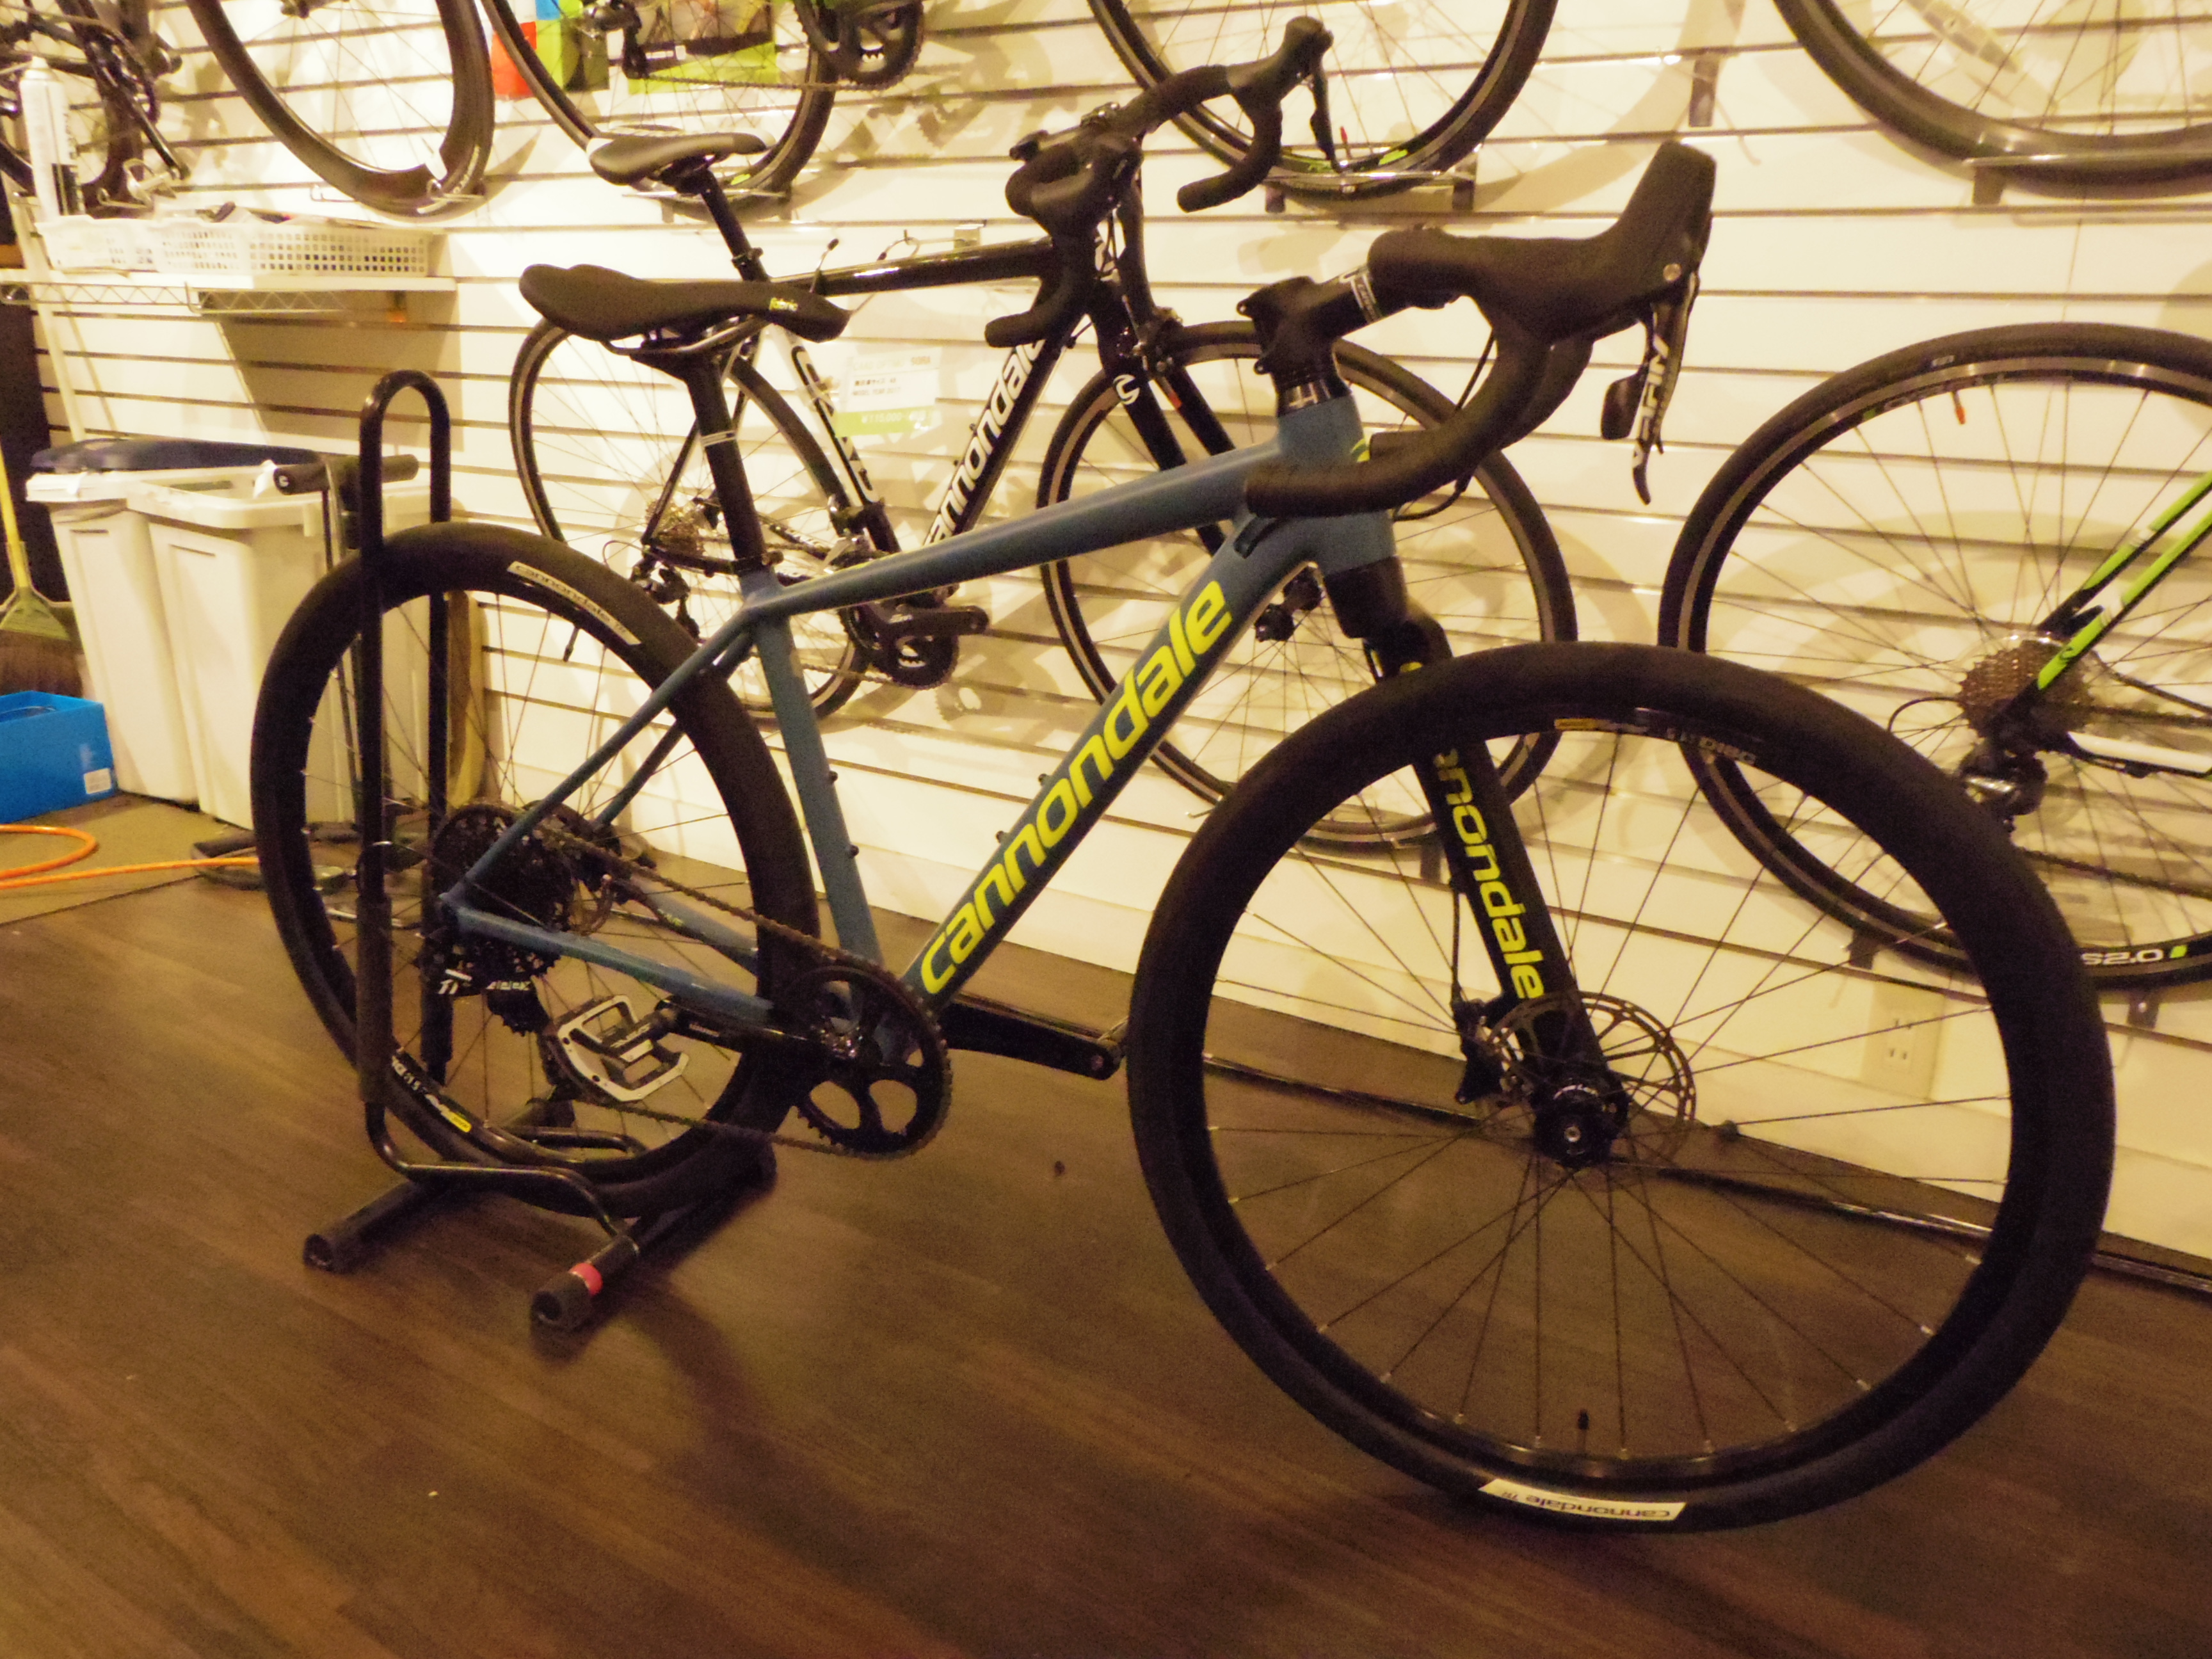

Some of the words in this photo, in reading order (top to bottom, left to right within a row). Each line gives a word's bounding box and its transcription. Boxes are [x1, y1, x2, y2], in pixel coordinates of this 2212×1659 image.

[924, 339, 1046, 546] annondal
[920, 580, 1233, 995] cannondale
[1525, 1495, 1671, 1518] cannondale
